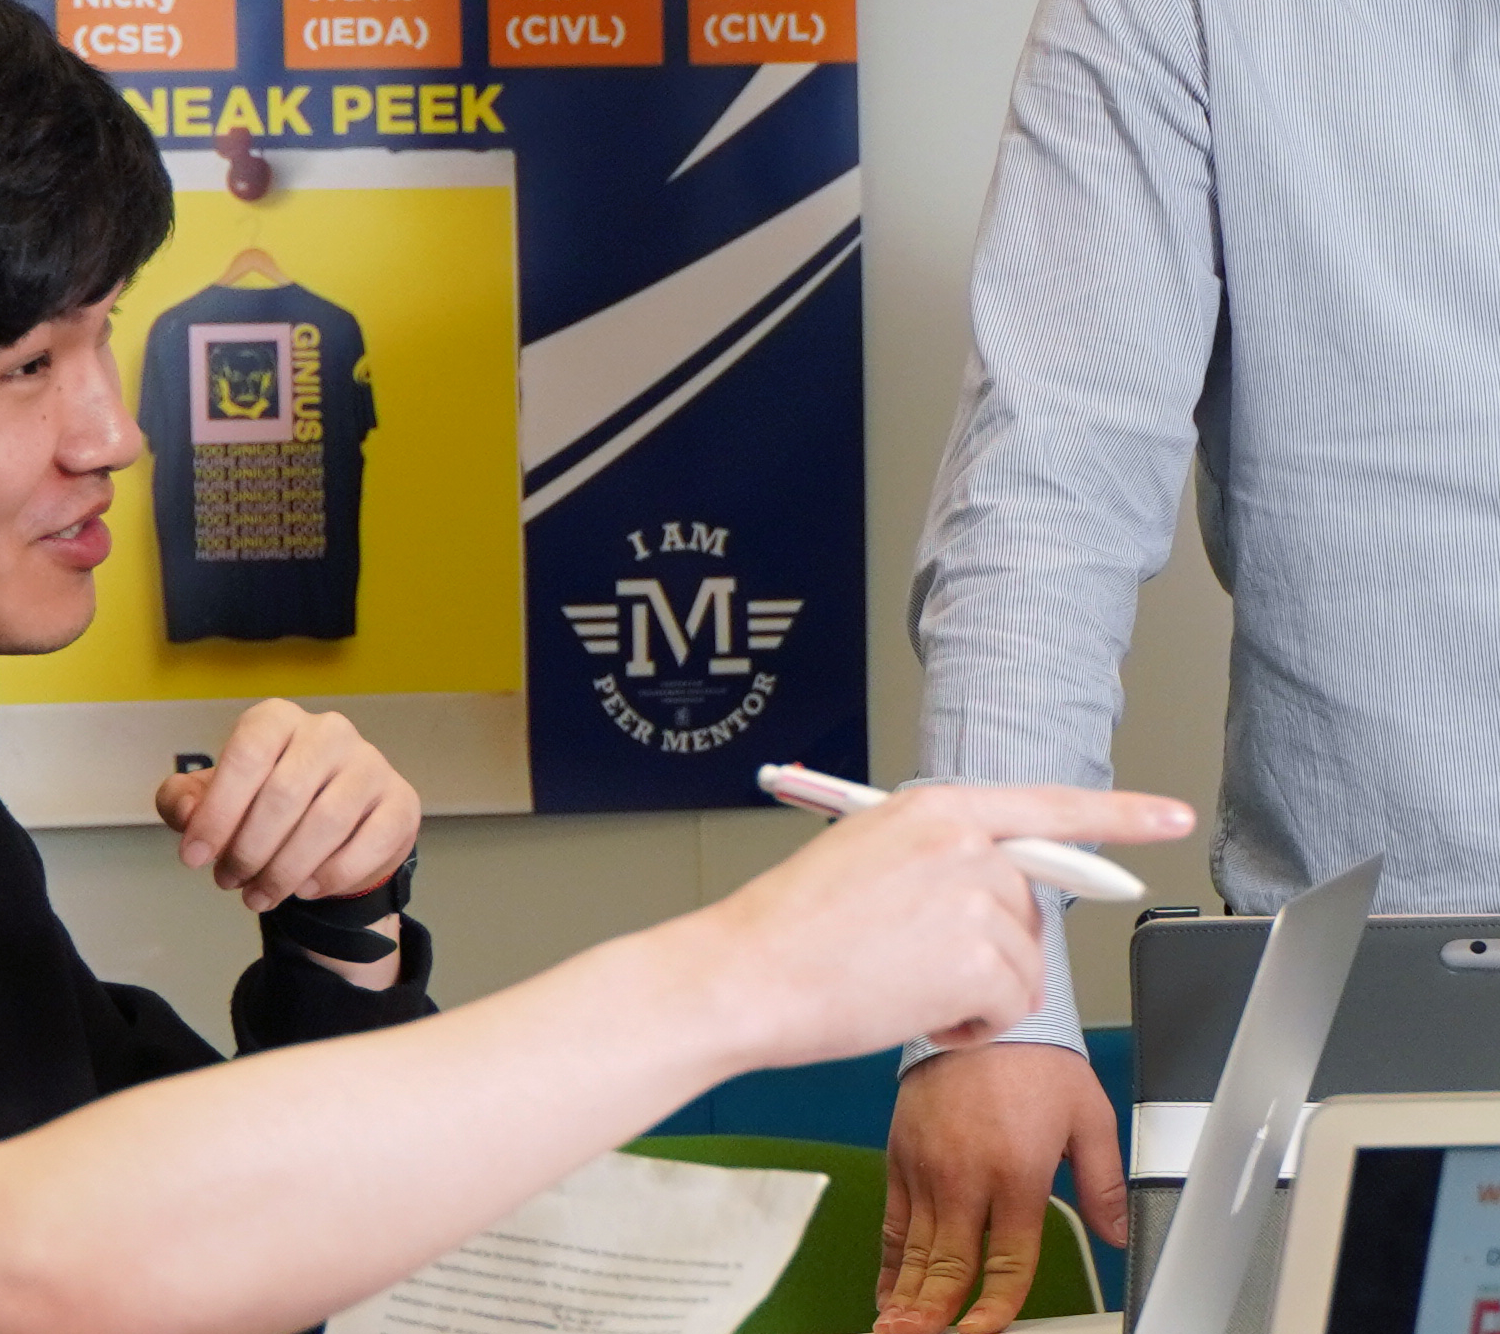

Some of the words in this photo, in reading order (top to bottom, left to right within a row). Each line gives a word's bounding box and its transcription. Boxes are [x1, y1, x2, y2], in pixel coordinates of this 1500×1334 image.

[73, 22, 183, 58] (CSE)
[303, 15, 431, 50] (IEDA)
[505, 13, 626, 49] (CIVL)
[703, 12, 827, 47] (CIVL)
[122, 85, 313, 138] NEAK
[332, 83, 506, 136] PEEK
[292, 322, 324, 443] GINIUS
[627, 529, 652, 561] I
[659, 521, 730, 559] AM
[592, 672, 655, 747] PEER
[659, 671, 779, 755] MENTOR
